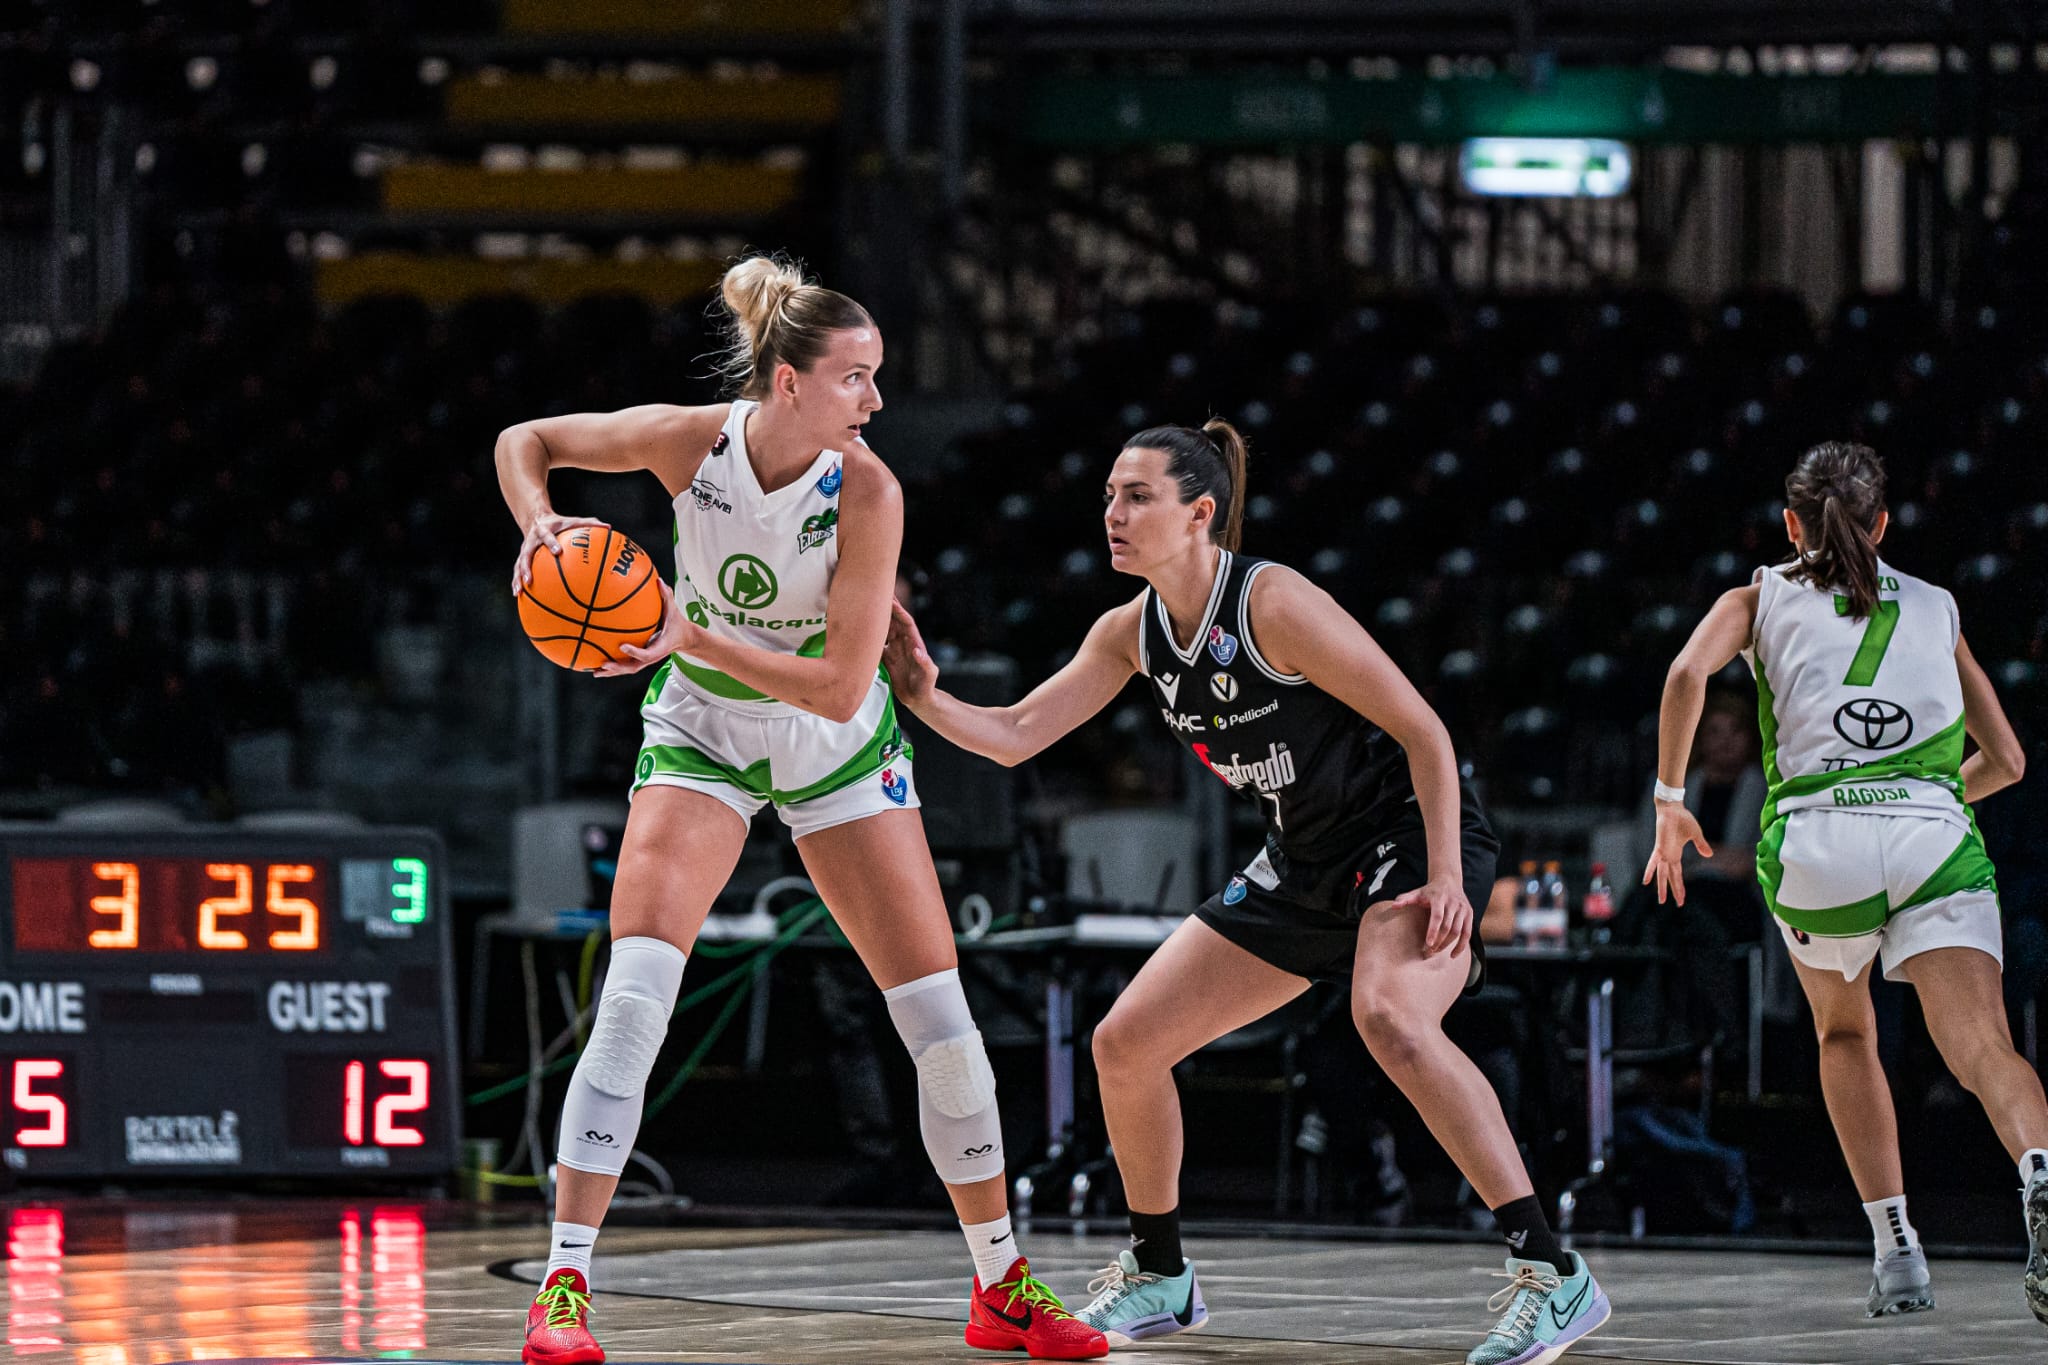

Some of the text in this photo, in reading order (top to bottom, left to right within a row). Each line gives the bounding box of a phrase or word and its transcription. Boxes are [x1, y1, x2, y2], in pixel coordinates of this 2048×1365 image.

[1216, 644, 1231, 657] LBF
[1832, 593, 1902, 688] 7
[1161, 708, 1207, 733] FAAC
[1229, 699, 1279, 727] Pelliconi
[1833, 787, 1911, 807] RAGUSA
[88, 862, 321, 951] 3 25
[390, 857, 429, 924] 3
[266, 980, 392, 1033] GUEST
[342, 1058, 431, 1148] 12
